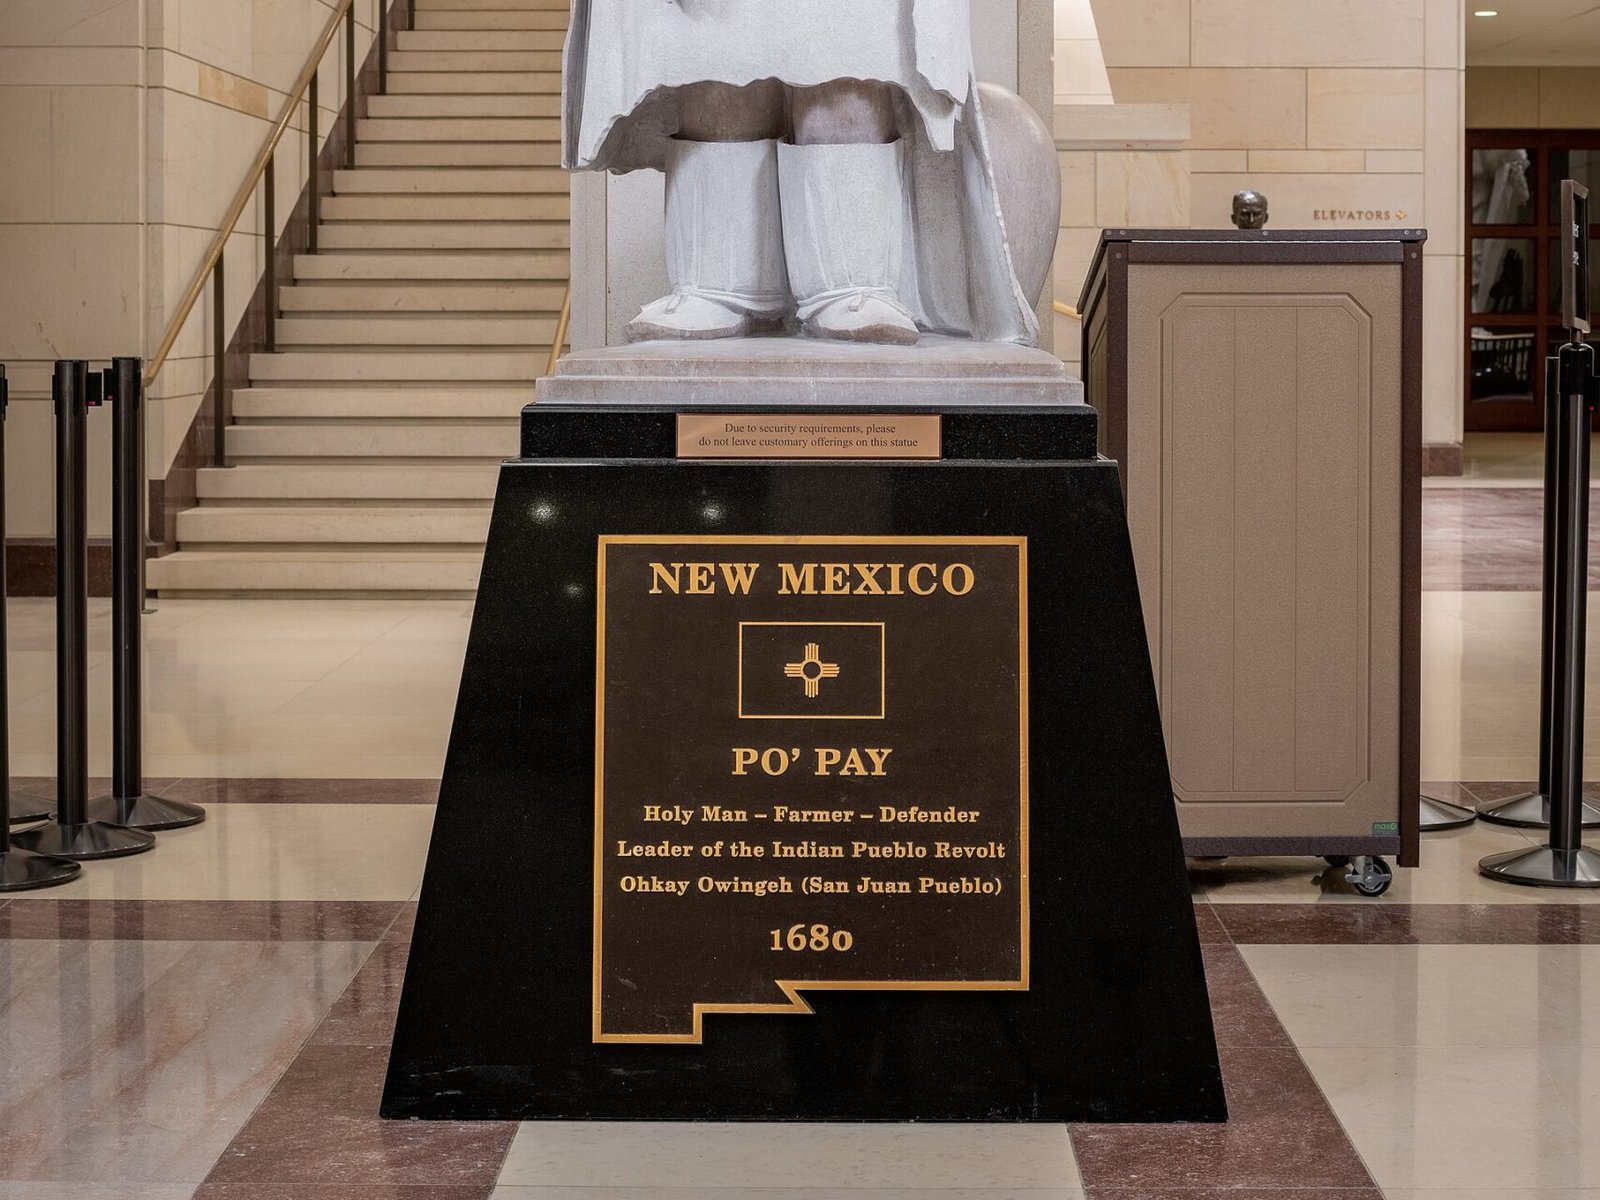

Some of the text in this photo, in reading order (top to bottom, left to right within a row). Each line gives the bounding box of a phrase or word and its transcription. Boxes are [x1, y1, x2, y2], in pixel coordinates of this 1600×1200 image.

[1313, 209, 1391, 221] ELEVATORS
[725, 423, 896, 435] Due to security requirements, please
[698, 437, 918, 449] do not leave customary offerings on this statue
[649, 562, 976, 596] NEW MEXICO
[732, 747, 893, 776] PO’ PAY
[643, 805, 694, 826] Holy
[701, 805, 748, 823] Man
[773, 805, 855, 823] Farmer
[879, 805, 980, 823] Defender
[616, 840, 1006, 859] Leader of the Indian Pueblo Revolt
[620, 875, 1003, 897] Ohkay Owingeh (San Juan Pueblo)
[769, 923, 855, 953] 1680
